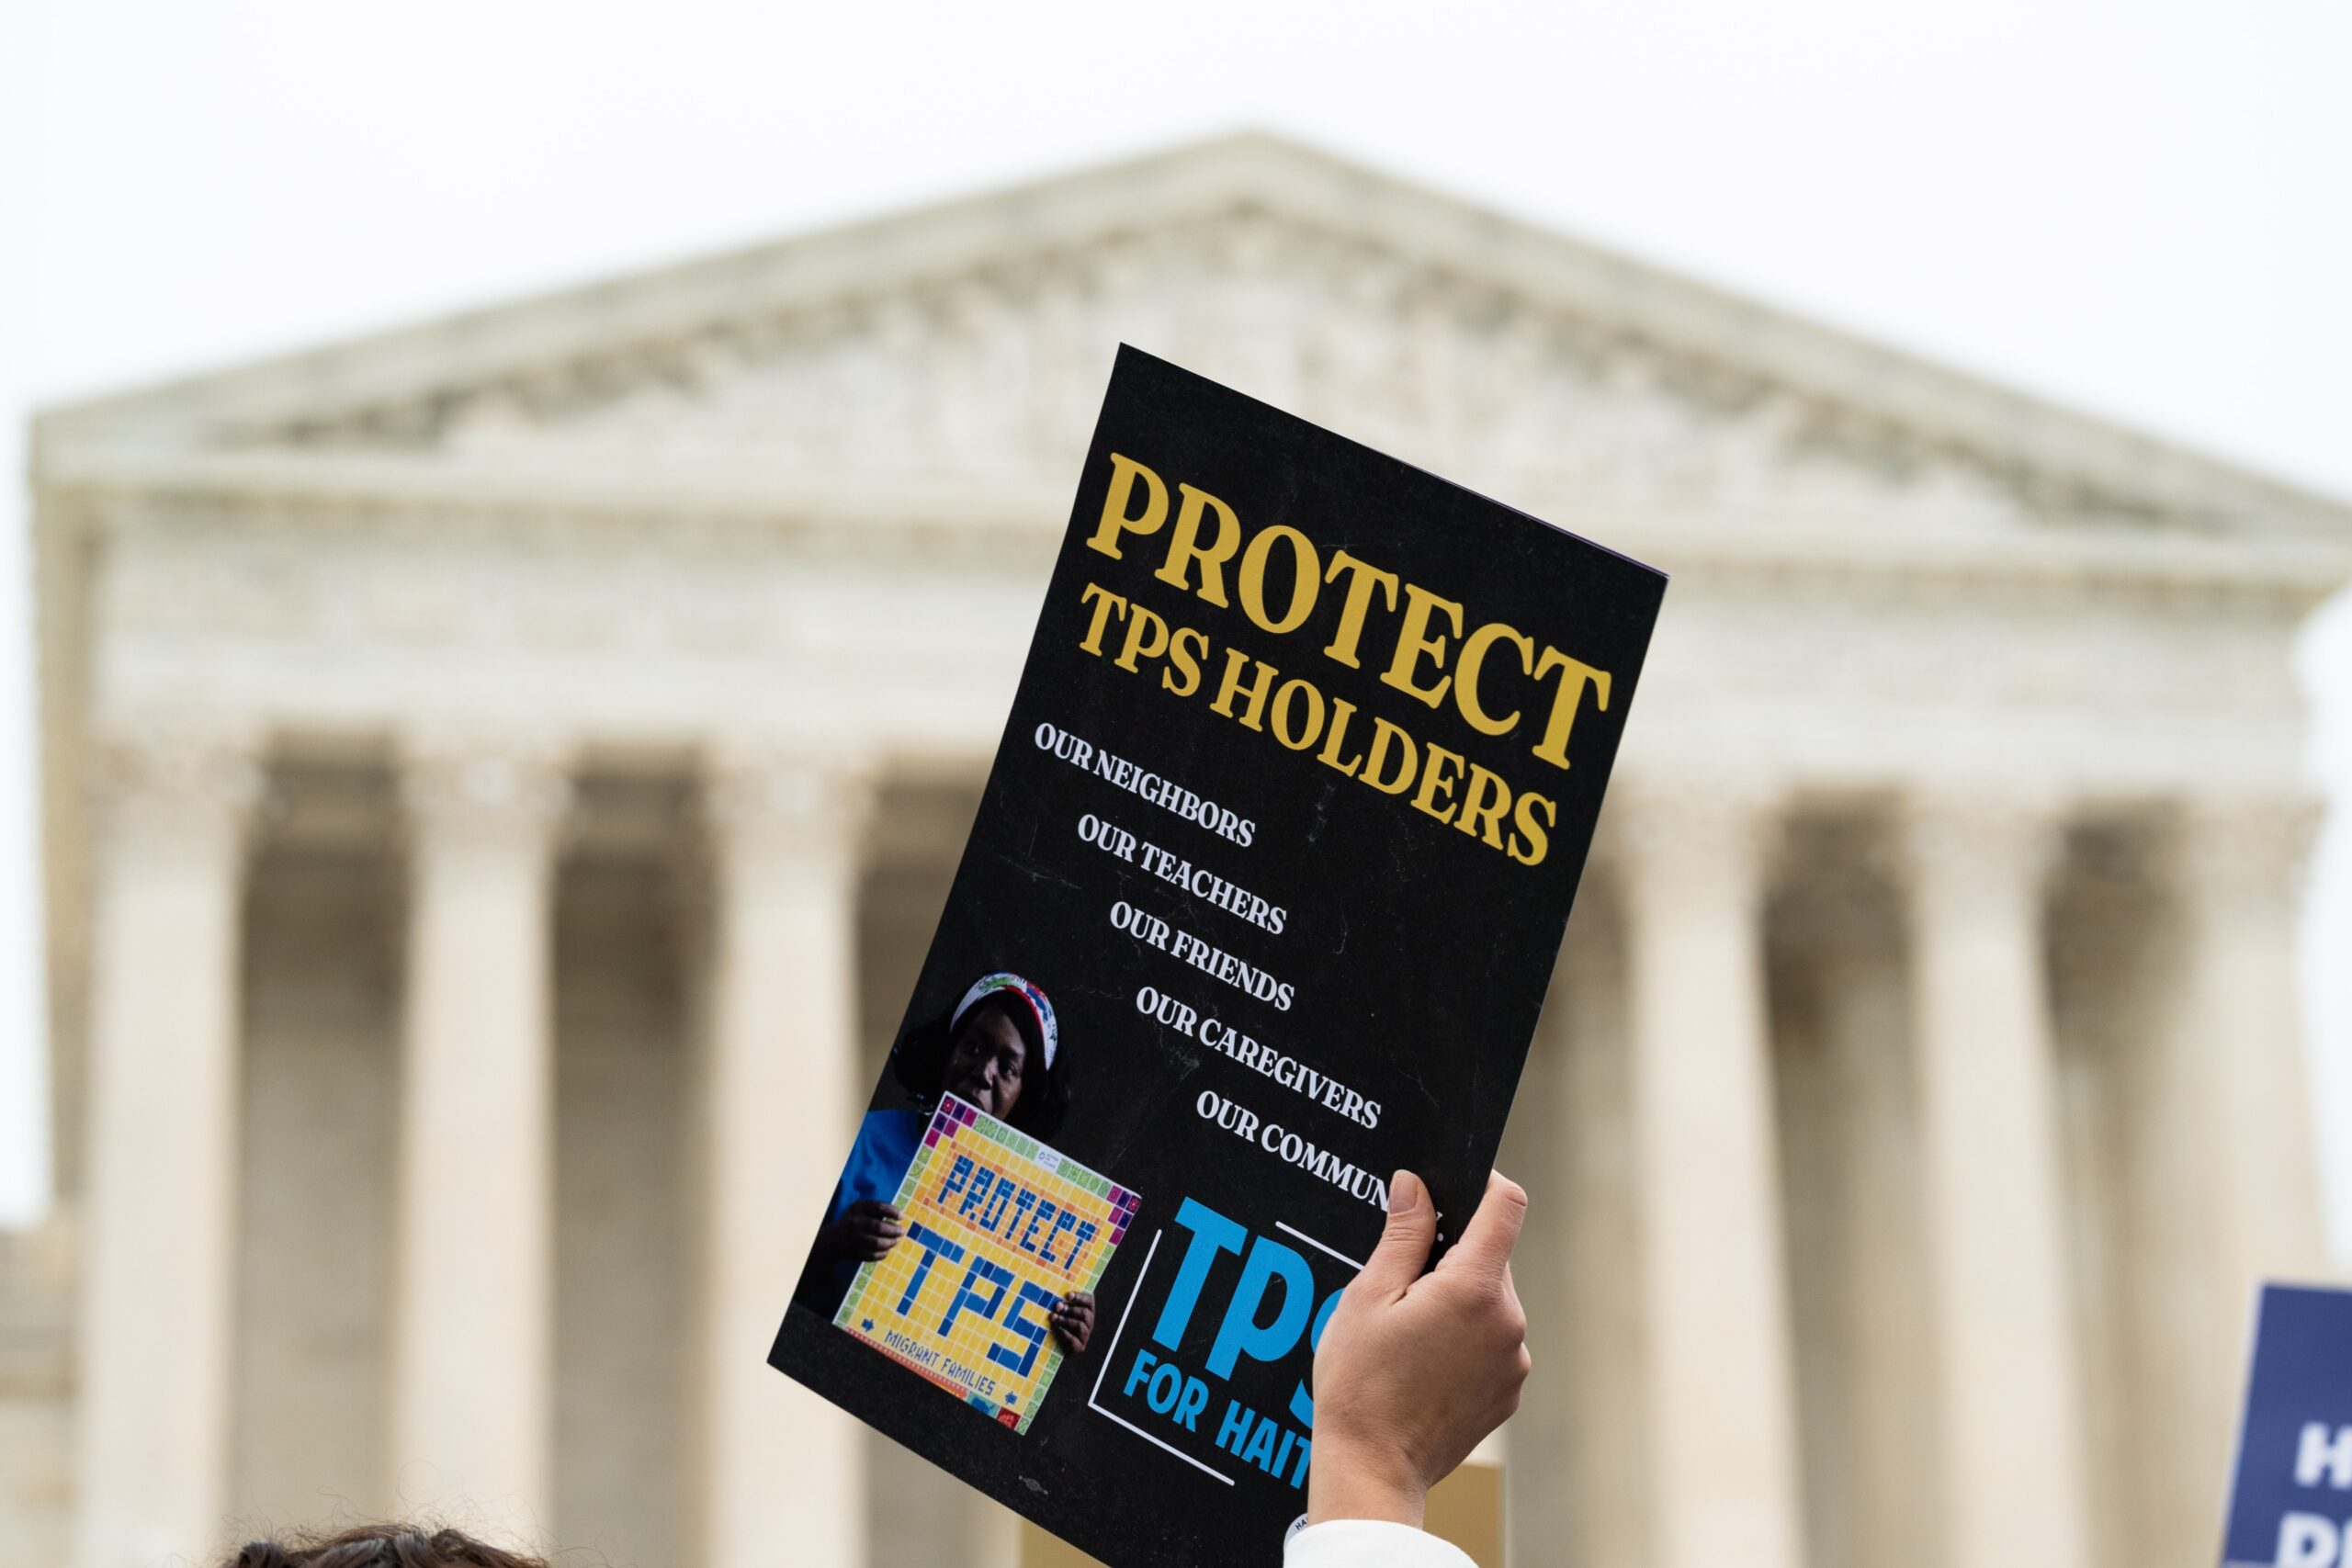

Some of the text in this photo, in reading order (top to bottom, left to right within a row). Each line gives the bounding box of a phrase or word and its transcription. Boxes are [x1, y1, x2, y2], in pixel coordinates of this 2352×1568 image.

[1086, 452, 1611, 771] PROTECT
[1035, 722, 1256, 848] OUR NEIGHBORS
[1079, 582, 1557, 867] TPS HOLDERS
[1078, 814, 1287, 936] OUR TEACHERS
[1110, 901, 1295, 1011] OUR FRIENDS
[1136, 986, 1382, 1130] OUR CAREGIVERS
[1196, 1090, 1260, 1143] OUR
[937, 1155, 1097, 1271] PROTECT
[896, 1220, 1063, 1378] TPS
[884, 1329, 996, 1396] MIGRANT FAMILIES
[1123, 1348, 1312, 1489] FOR HAIT
